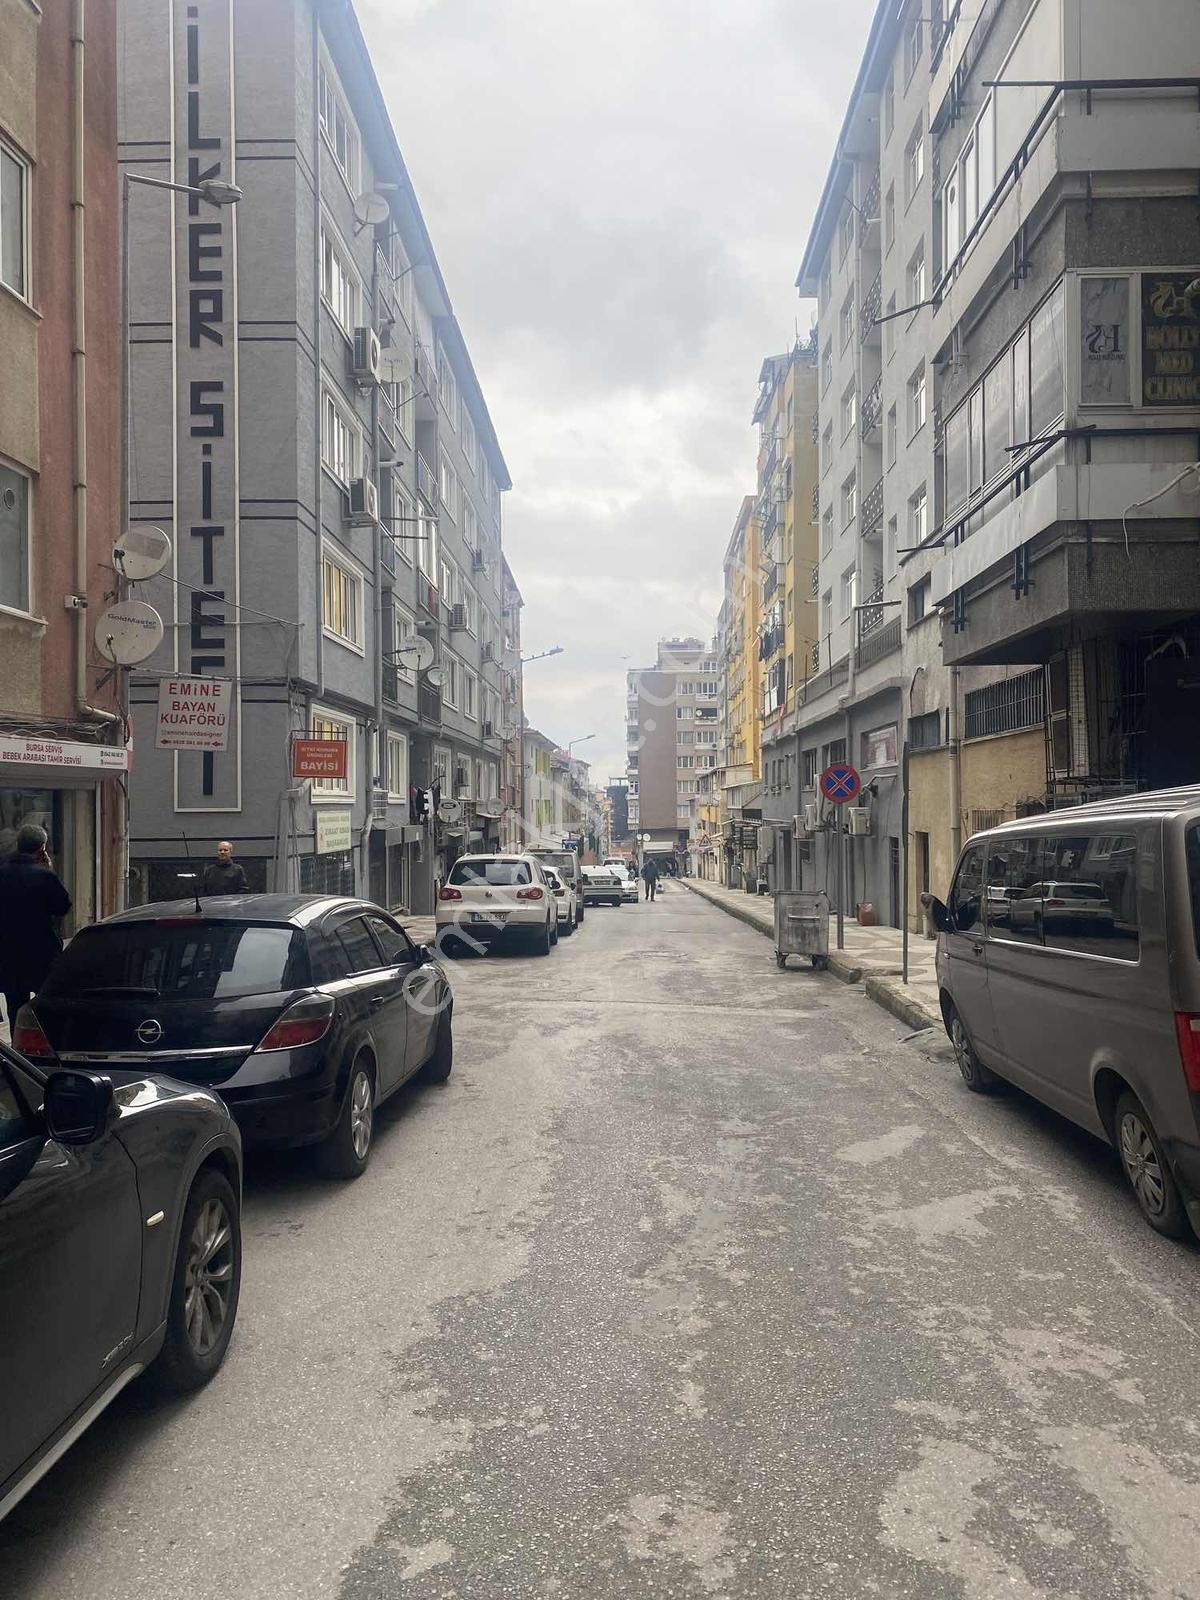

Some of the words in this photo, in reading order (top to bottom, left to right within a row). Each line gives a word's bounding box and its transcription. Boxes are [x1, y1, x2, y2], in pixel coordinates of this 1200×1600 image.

[107, 613, 157, 625] GoldMaster
[172, 701, 216, 712] BAYAN
[160, 712, 226, 726] KUAFÖRÜ
[26, 743, 44, 752] BURSA
[45, 744, 63, 754] SERVİS
[2, 751, 21, 760] BEBEK
[22, 753, 46, 762] ARABASI
[47, 754, 63, 763] TAMİR
